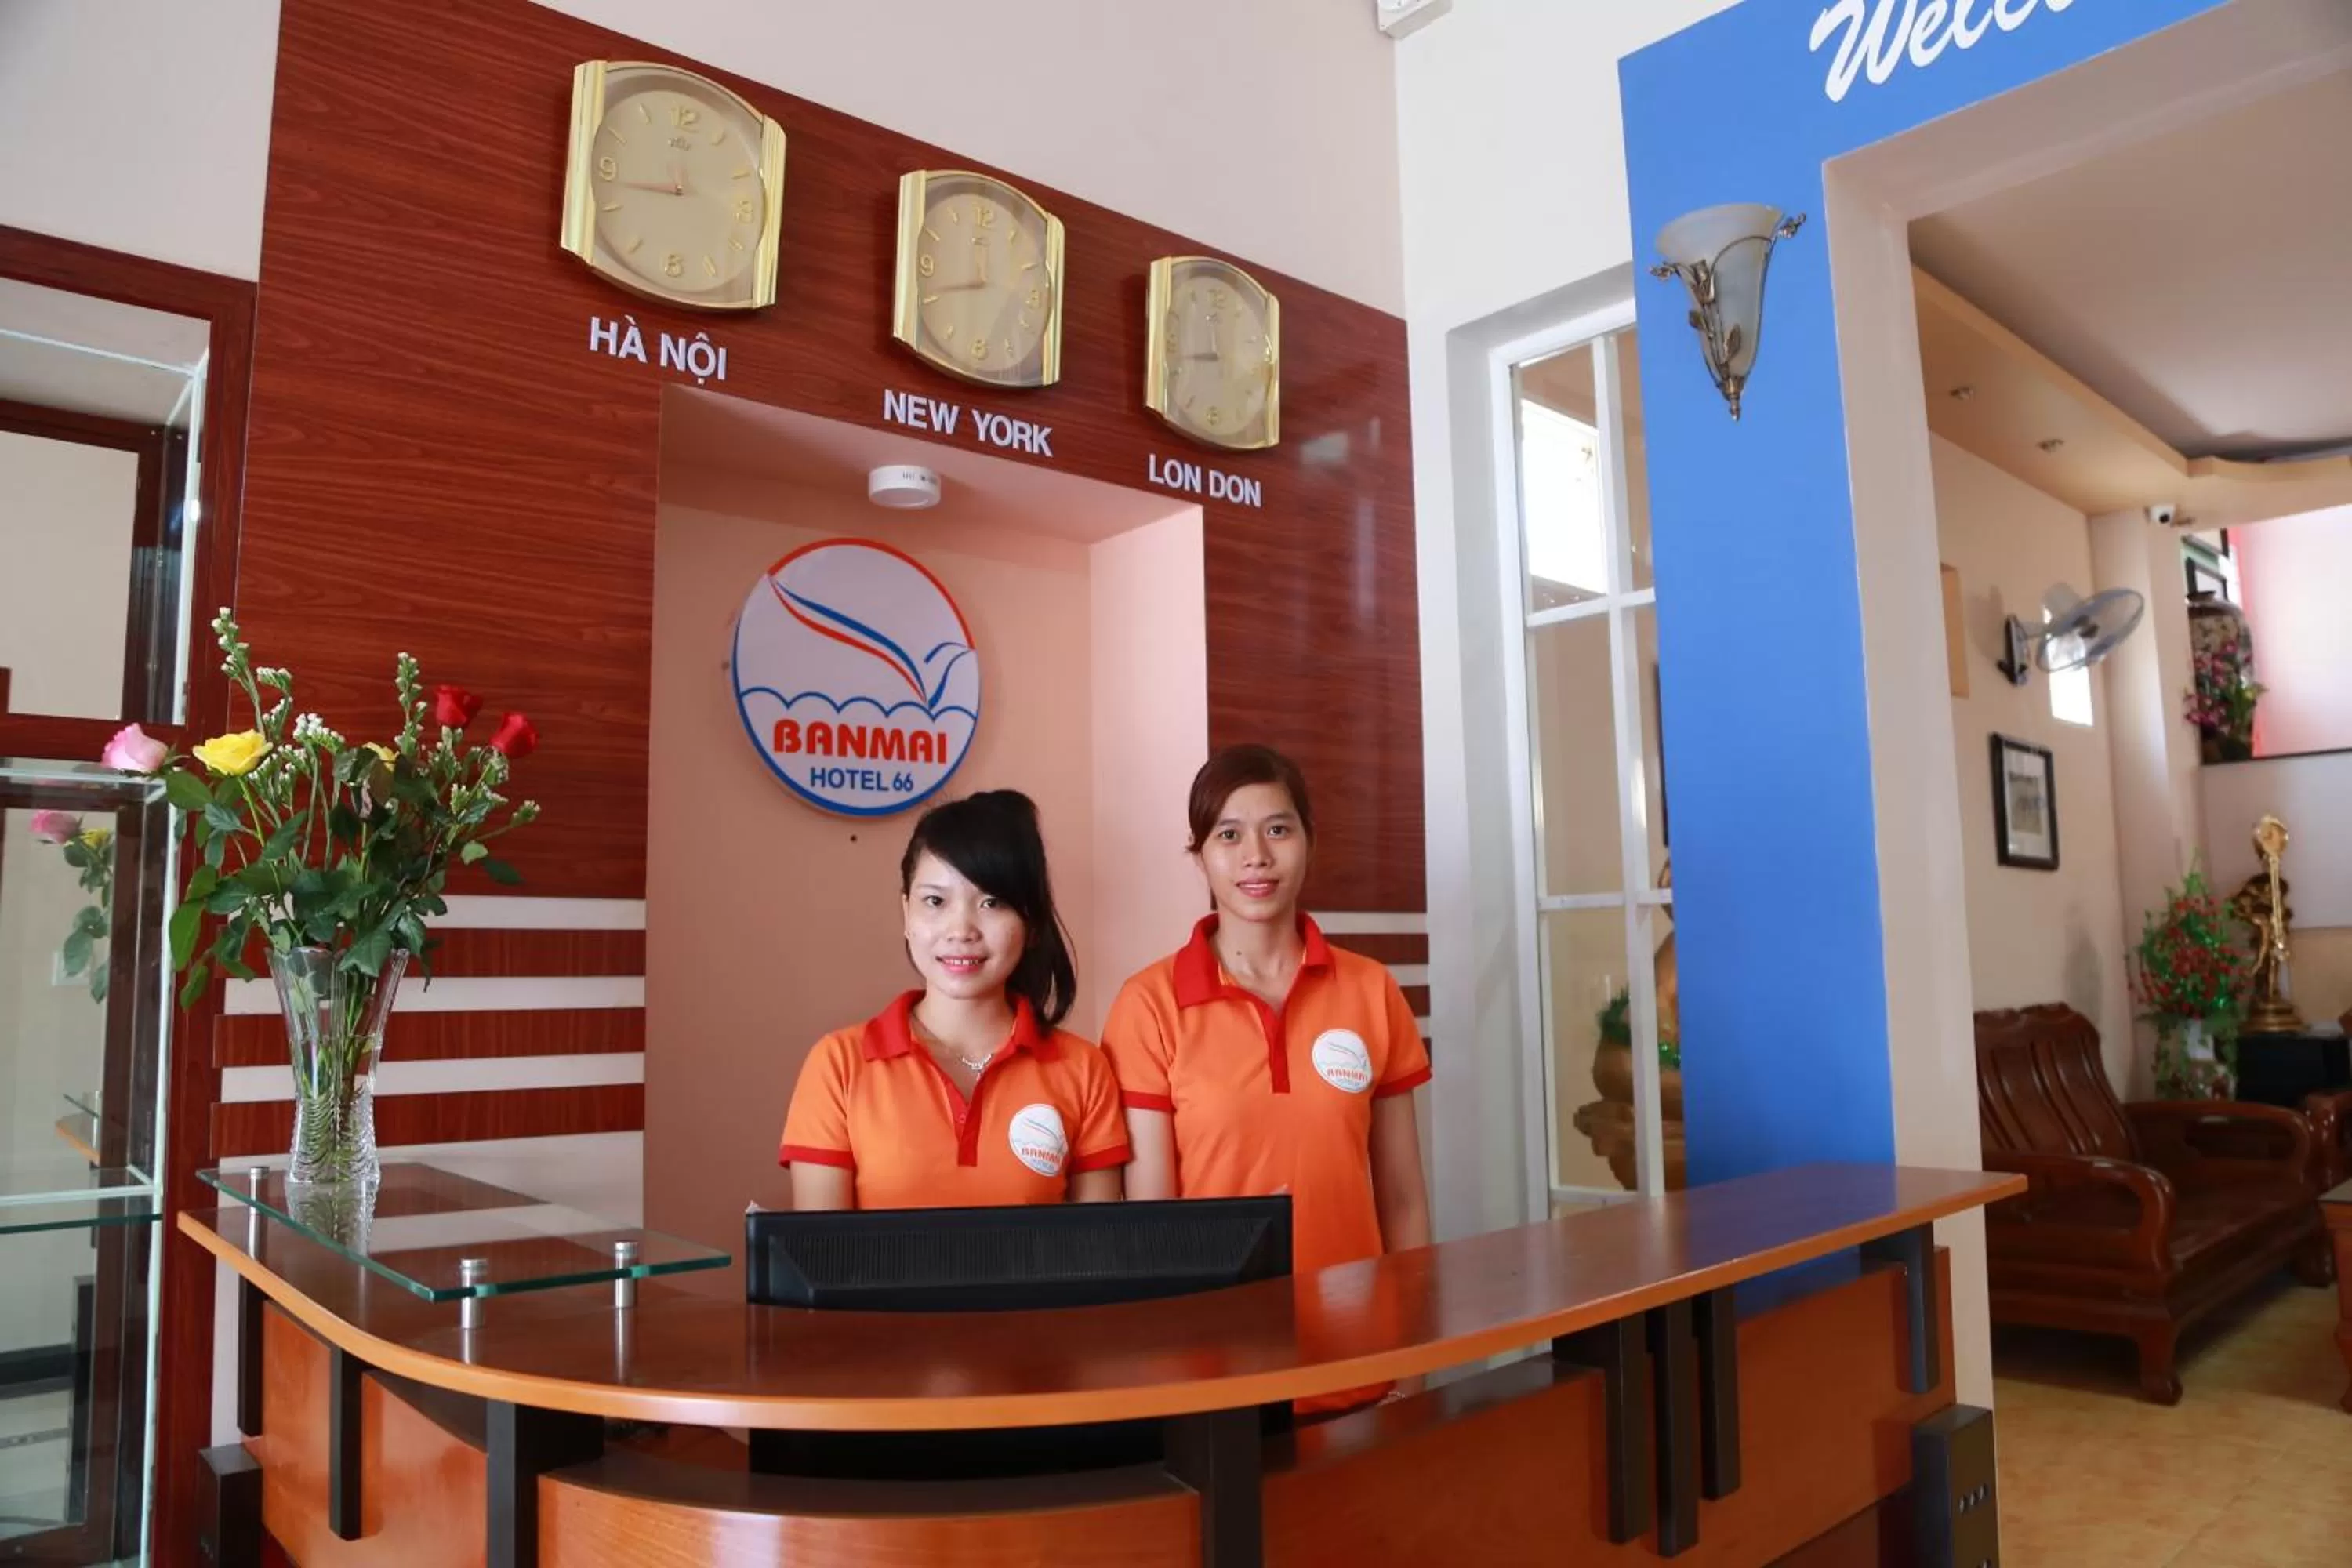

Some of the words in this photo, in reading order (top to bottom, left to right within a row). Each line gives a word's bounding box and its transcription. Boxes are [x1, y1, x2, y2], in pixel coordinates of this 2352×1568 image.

[1809, 0, 2074, 103] Welc
[671, 105, 701, 133] 12
[599, 157, 616, 181] 9
[920, 254, 934, 277] 9
[590, 315, 647, 362] HÀ
[659, 332, 727, 384] NỘI
[884, 389, 960, 434] NEW
[971, 409, 1053, 456] YORK
[1149, 453, 1201, 492] LON
[1209, 470, 1261, 507] DON
[774, 719, 947, 764] BANMAI
[811, 768, 889, 791] HOTEL
[893, 772, 913, 792] 66
